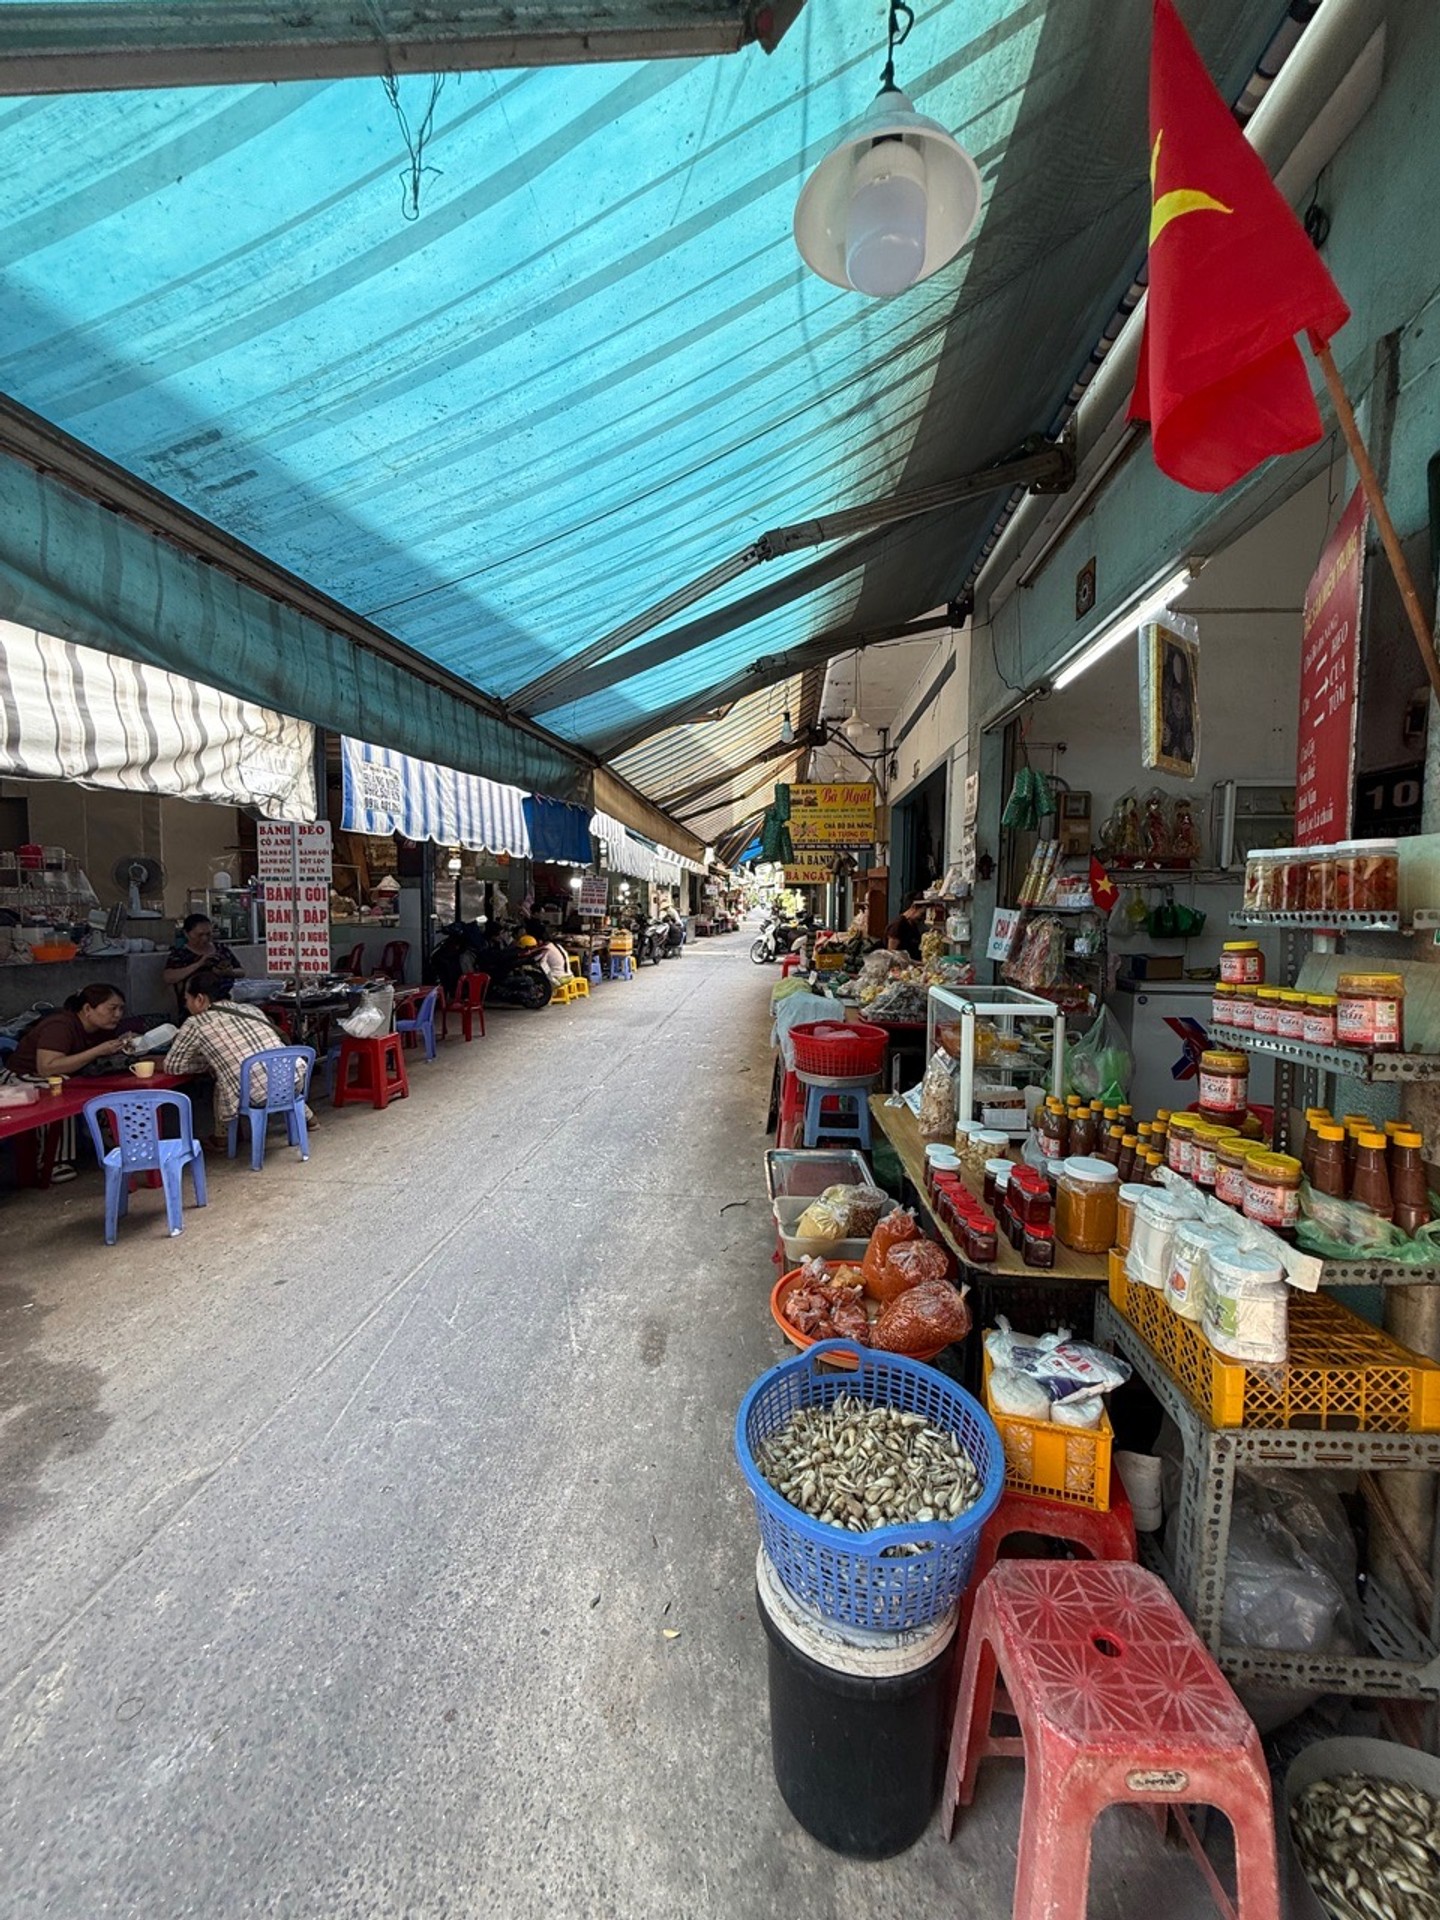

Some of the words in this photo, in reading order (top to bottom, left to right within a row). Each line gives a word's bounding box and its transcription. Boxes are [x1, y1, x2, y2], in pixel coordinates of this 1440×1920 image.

[260, 824, 291, 835] BÁNH
[305, 883, 327, 901] GÓI
[303, 906, 327, 926] ĐẬP
[301, 945, 328, 957] XÀO
[269, 959, 292, 971] MÍT
